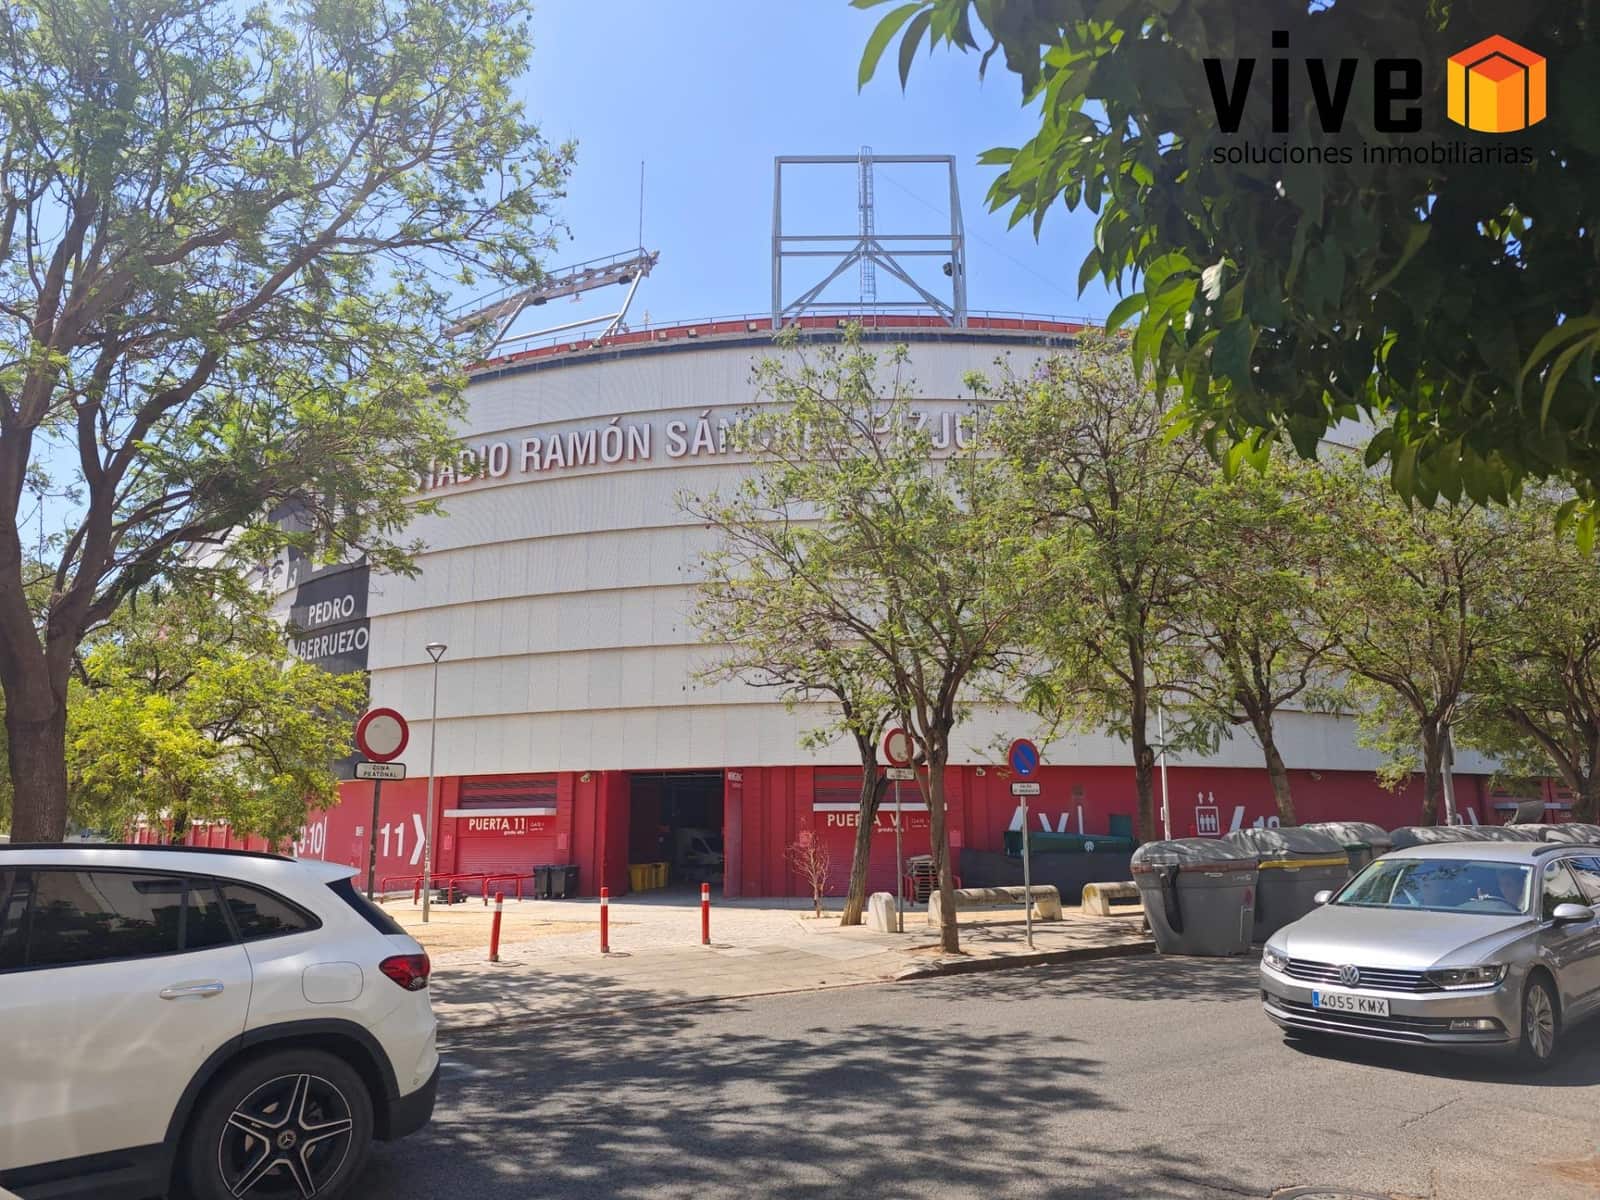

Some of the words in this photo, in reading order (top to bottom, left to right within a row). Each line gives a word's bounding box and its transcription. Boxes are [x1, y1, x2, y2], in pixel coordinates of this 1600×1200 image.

[520, 417, 651, 473] RAMÓN
[308, 594, 355, 625] PEDRO
[300, 627, 369, 661] BERRUEZO
[380, 822, 405, 857] 11
[469, 818, 510, 830] PUERTA
[514, 817, 525, 830] 11
[1321, 994, 1354, 1010] 4055
[1358, 998, 1385, 1014] KMX
